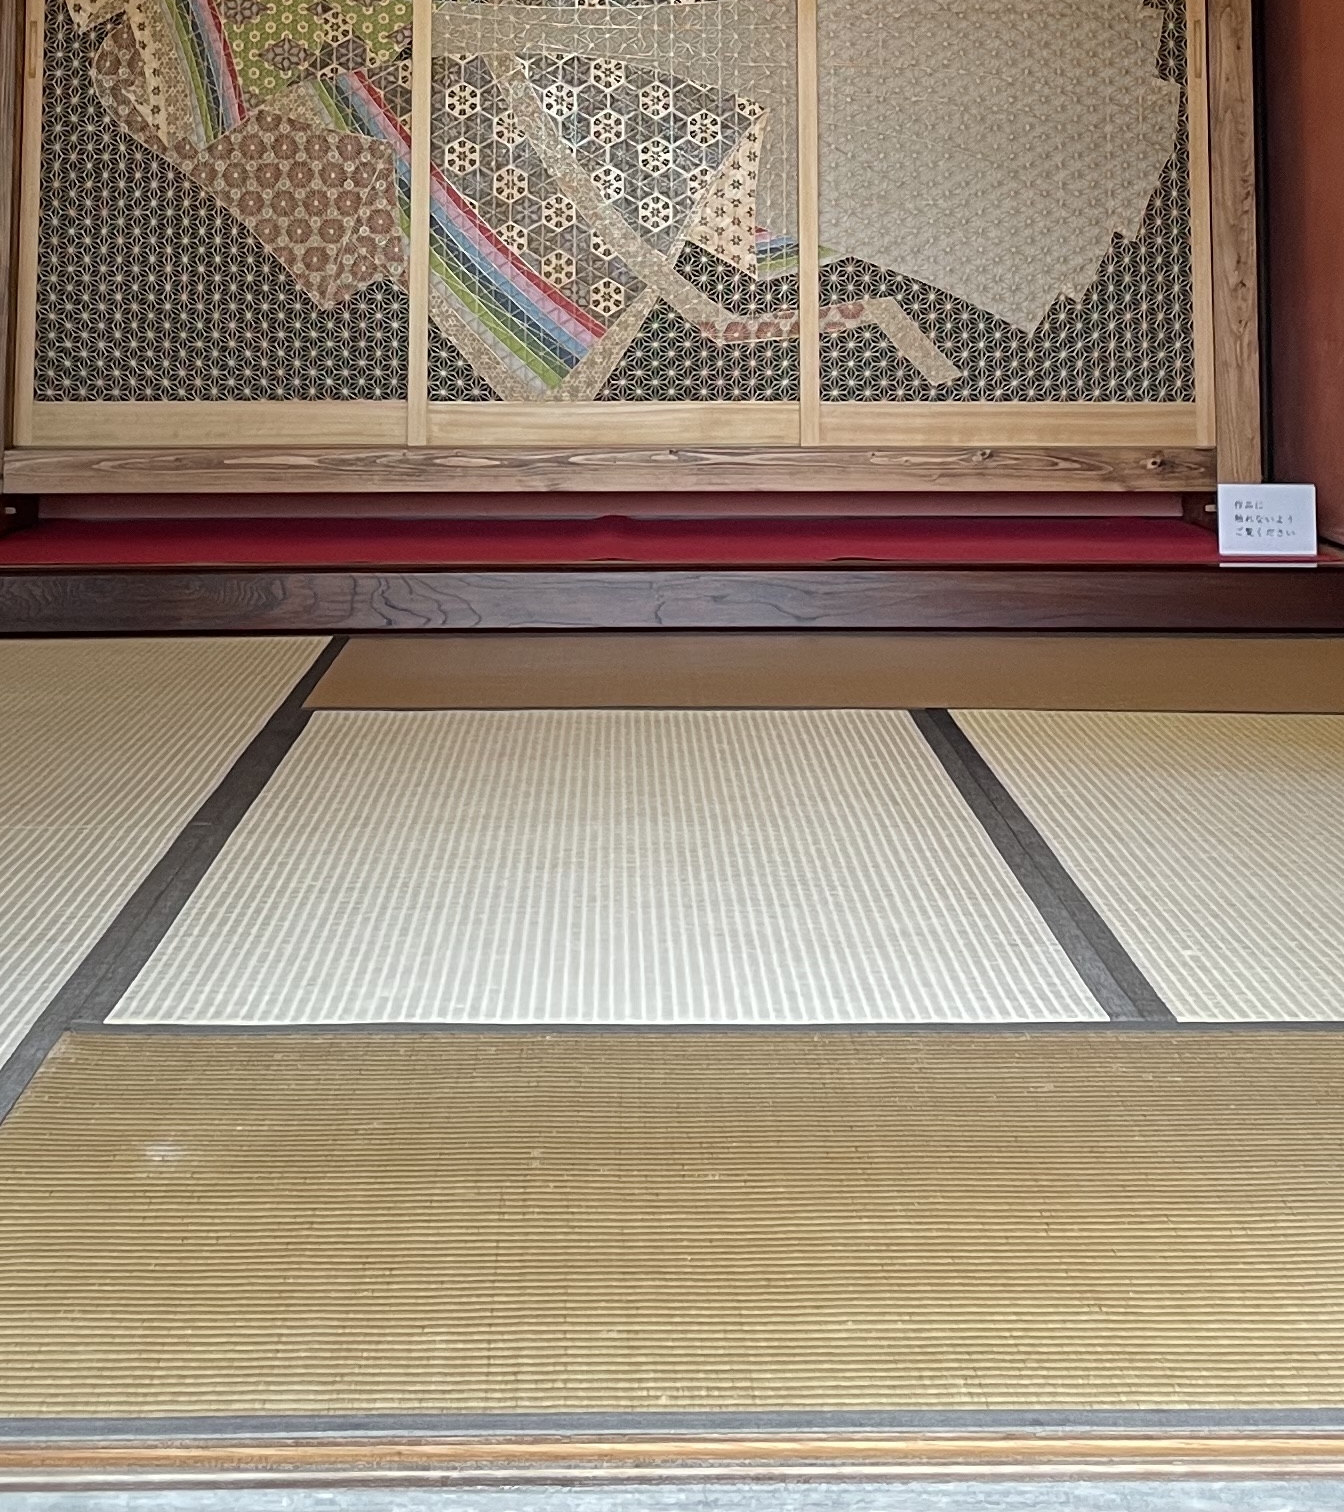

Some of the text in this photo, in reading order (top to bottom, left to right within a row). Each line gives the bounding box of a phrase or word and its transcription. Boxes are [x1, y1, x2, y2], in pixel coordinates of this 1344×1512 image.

[1234, 500, 1263, 510] 作品に
[1234, 514, 1293, 524] 触れないよう
[1235, 527, 1296, 538] ご覧ください
